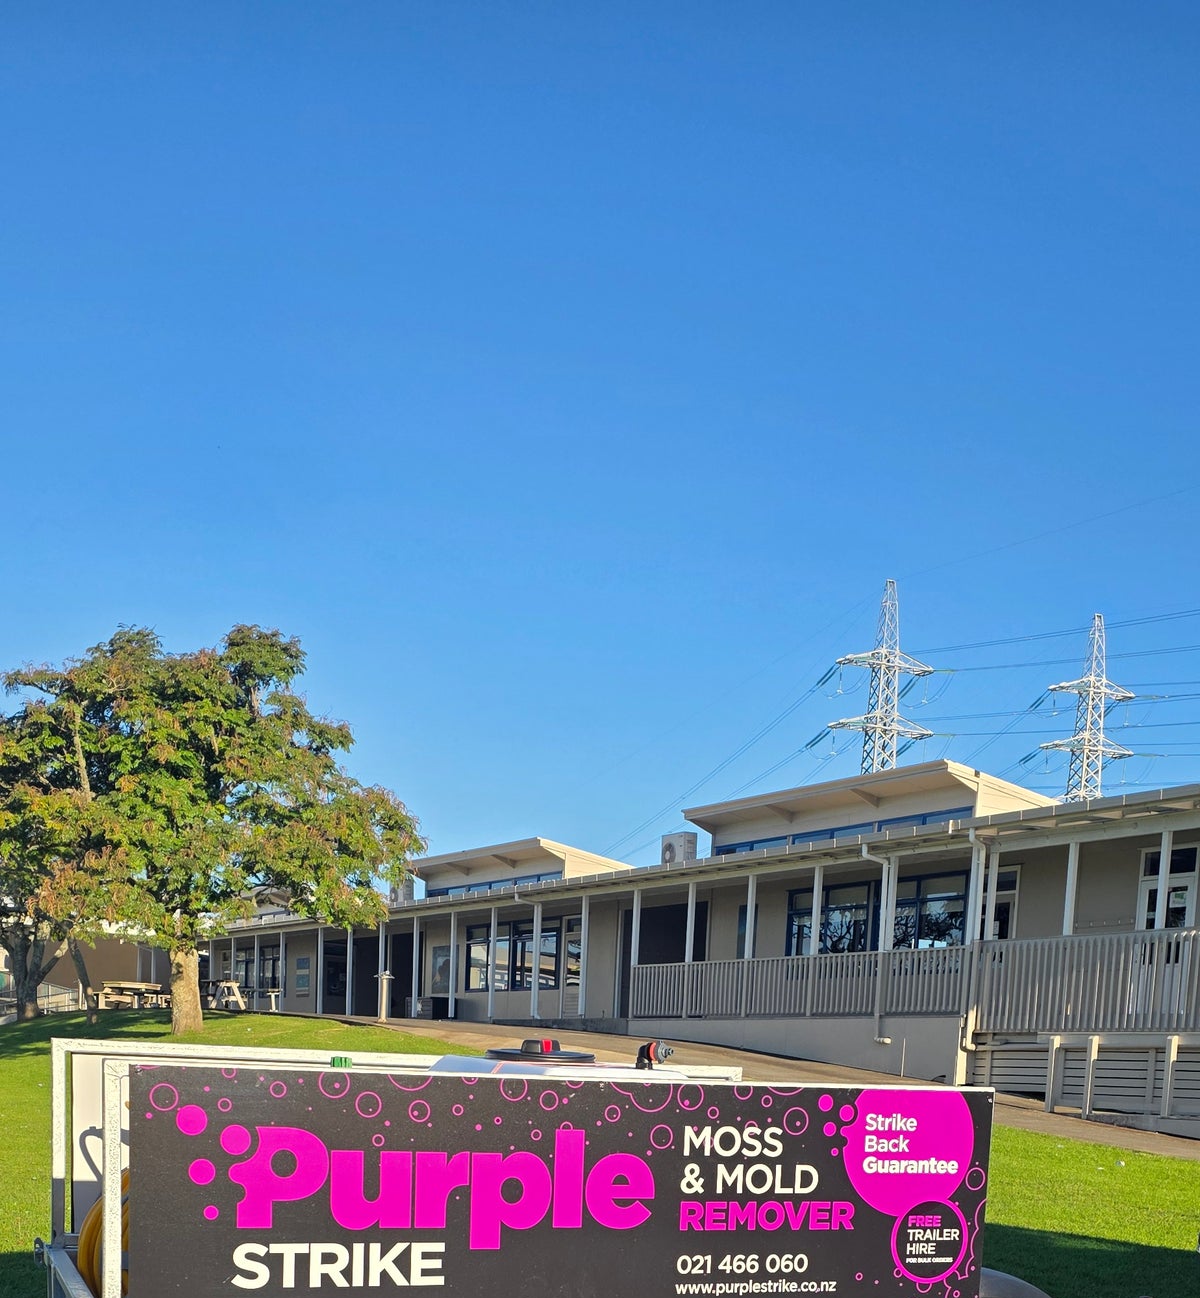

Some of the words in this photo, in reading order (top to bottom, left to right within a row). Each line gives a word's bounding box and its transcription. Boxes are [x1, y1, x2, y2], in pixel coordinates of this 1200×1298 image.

[865, 1113, 918, 1132] Strike
[683, 1125, 784, 1158] MOSS
[864, 1134, 910, 1153] Back
[862, 1156, 959, 1175] Guarantee
[228, 1126, 655, 1250] Purple
[680, 1162, 705, 1194] &
[716, 1163, 819, 1195] MOLD
[679, 1200, 855, 1232] REMOVER
[908, 1215, 942, 1227] FREE
[907, 1228, 960, 1241] TRAILER
[906, 1242, 937, 1255] HIRE
[230, 1241, 446, 1290] STRIKE
[676, 1254, 712, 1275] 021
[717, 1253, 760, 1274] 466
[765, 1253, 809, 1274] 060
[675, 1278, 837, 1297] www.purplestrike.co.nz
